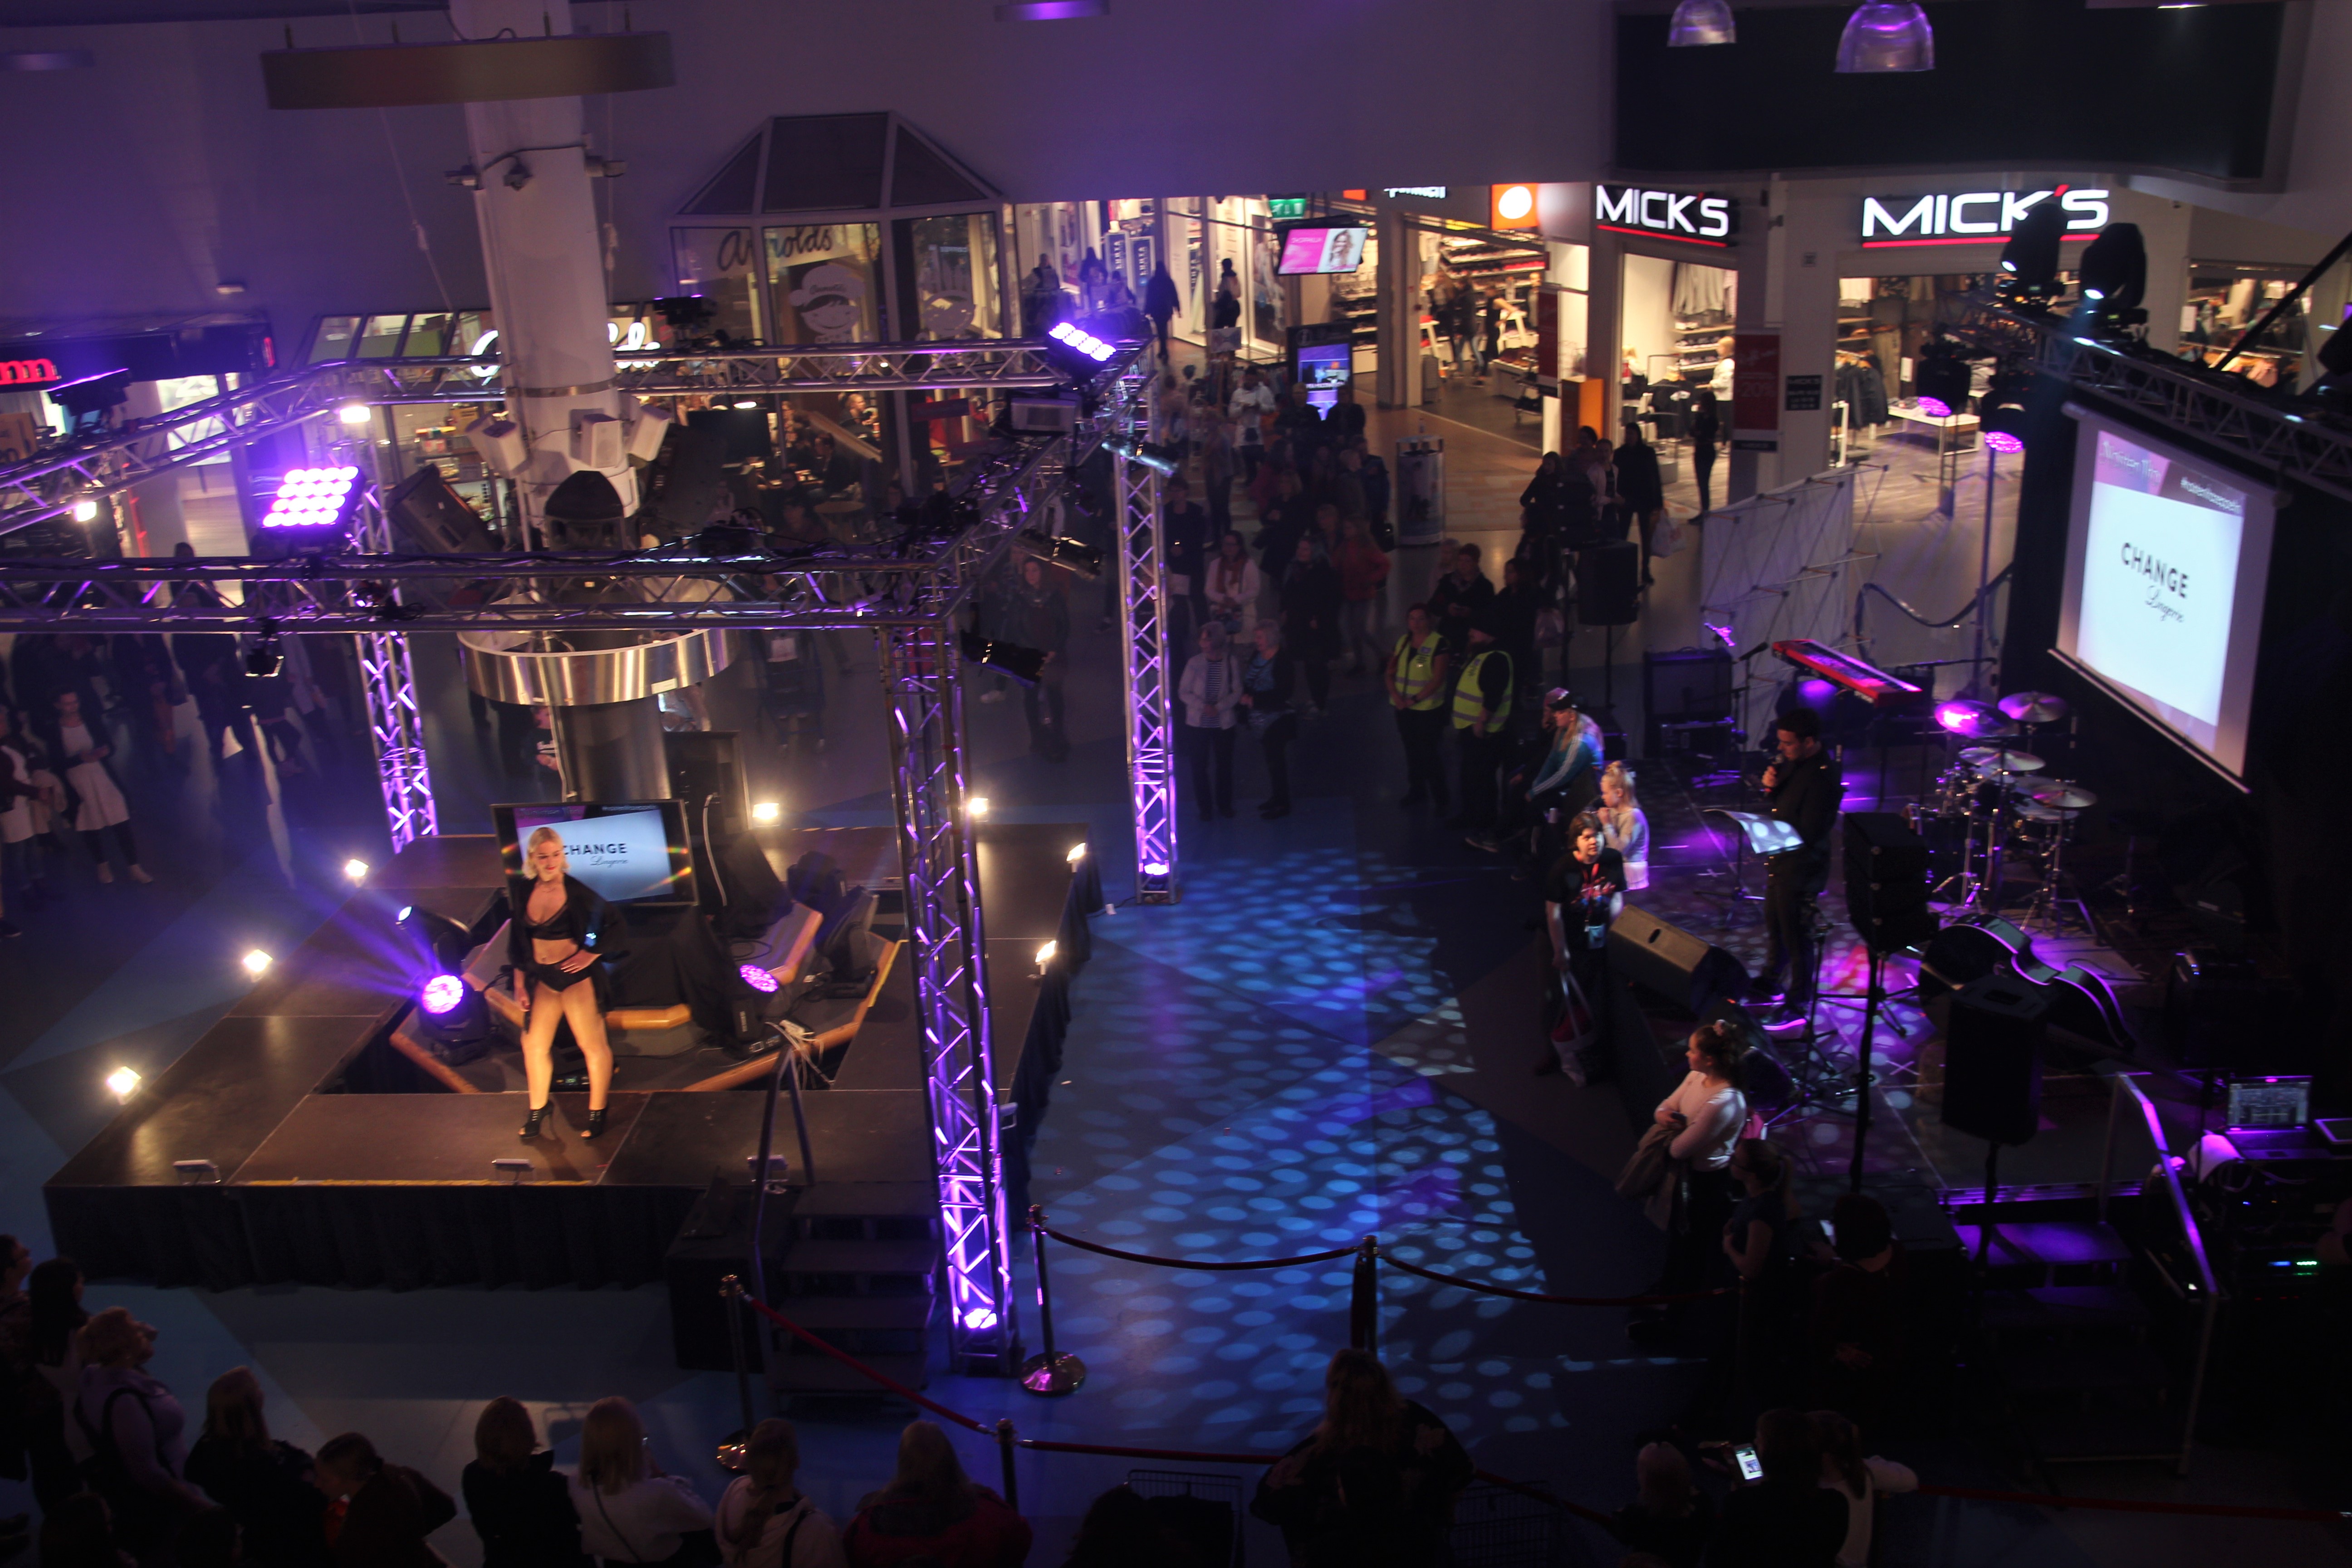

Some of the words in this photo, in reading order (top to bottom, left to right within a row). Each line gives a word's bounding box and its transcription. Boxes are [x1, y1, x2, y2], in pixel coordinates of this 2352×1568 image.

[1596, 185, 1729, 237] MICK'S
[1862, 184, 2109, 237] MICK'S
[2121, 543, 2188, 598] CHANGE
[563, 843, 628, 855] CHANGE
